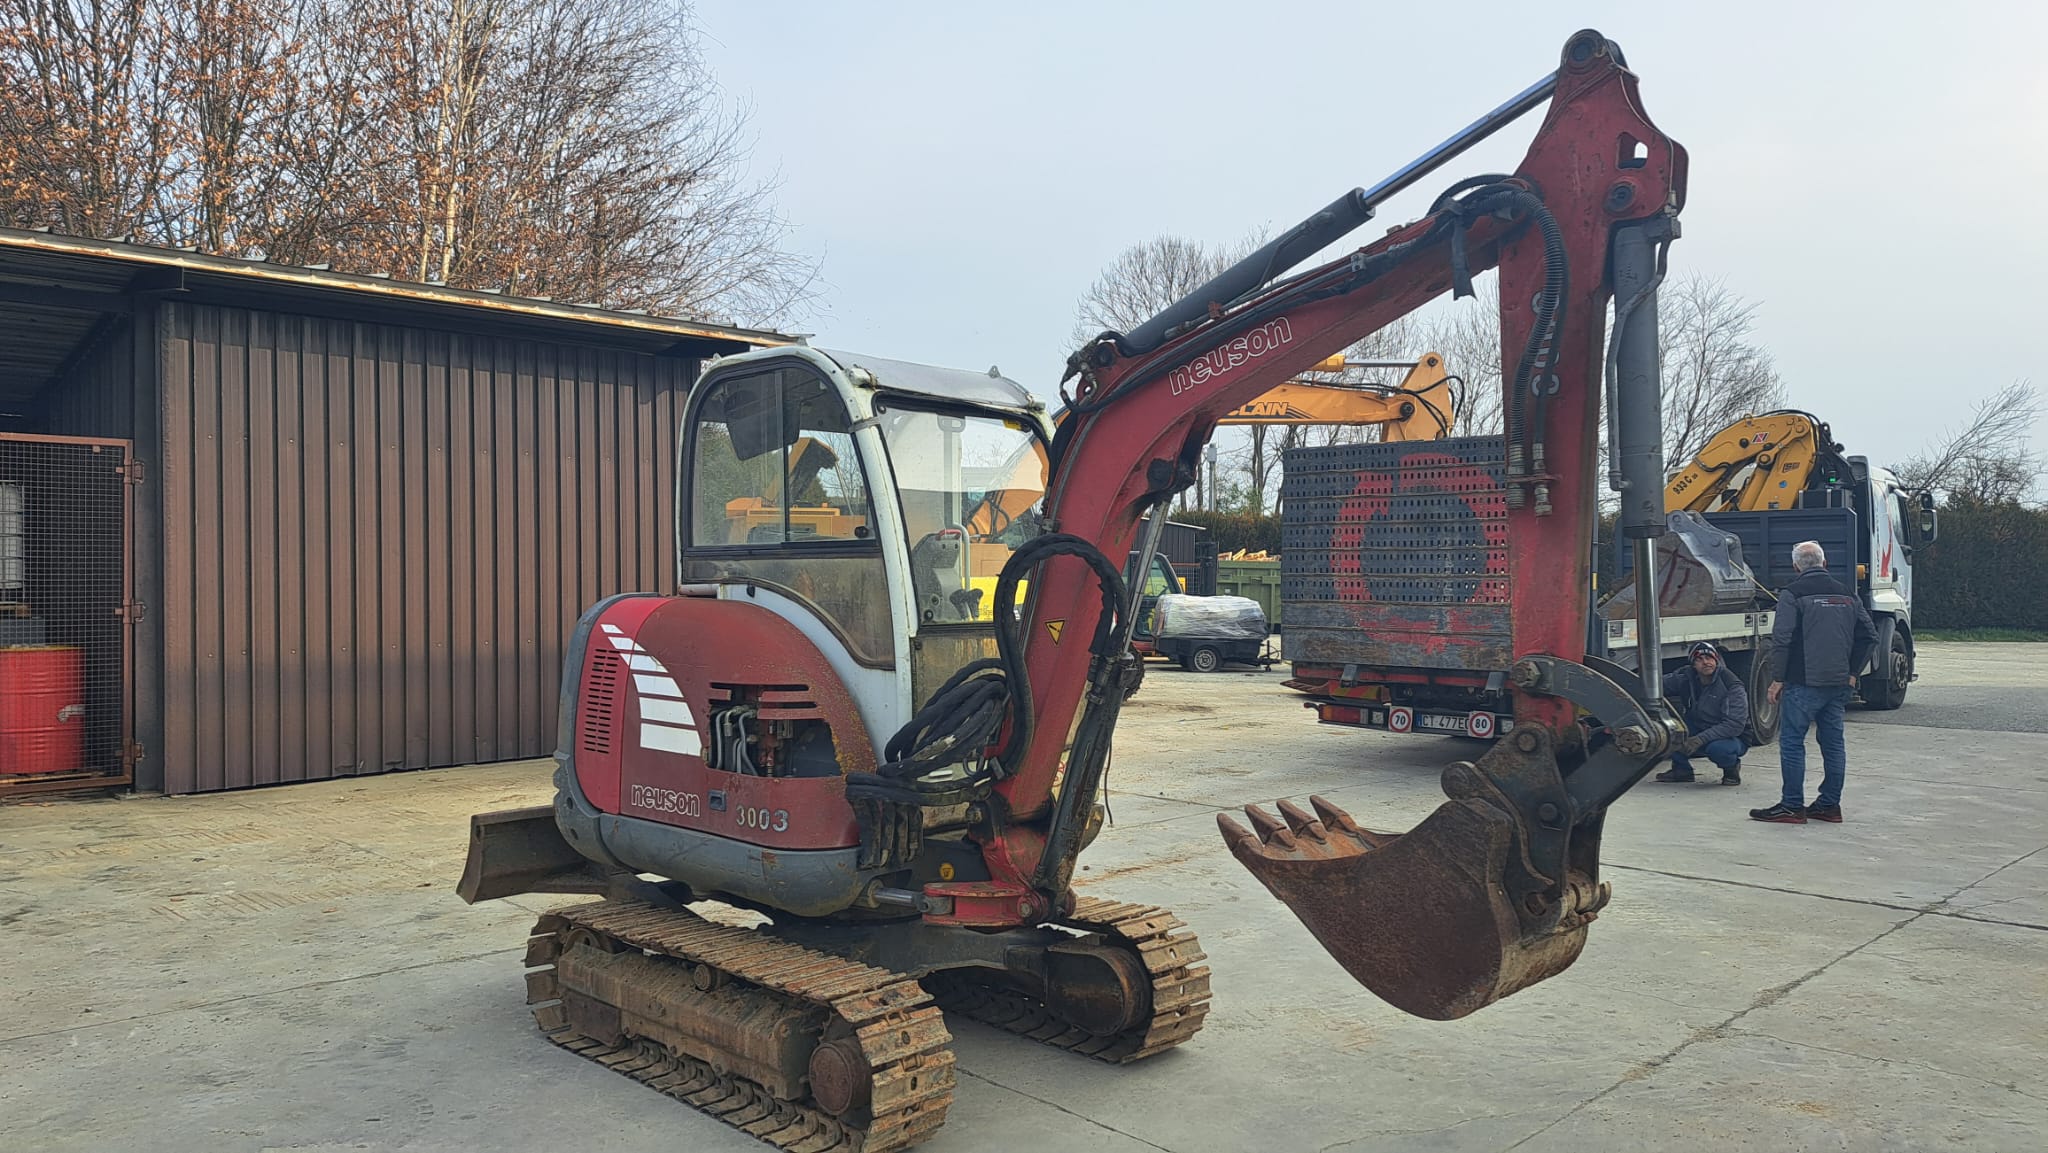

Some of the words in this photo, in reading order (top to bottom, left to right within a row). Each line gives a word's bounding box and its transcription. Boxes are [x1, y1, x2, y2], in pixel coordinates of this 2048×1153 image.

[1168, 316, 1293, 396] neuson
[1227, 401, 1290, 416] LAIN
[1395, 714, 1406, 726] 70
[1422, 714, 1435, 727] CT
[1475, 718, 1487, 729] 80
[631, 784, 700, 817] neuson
[736, 804, 789, 832] 3003
